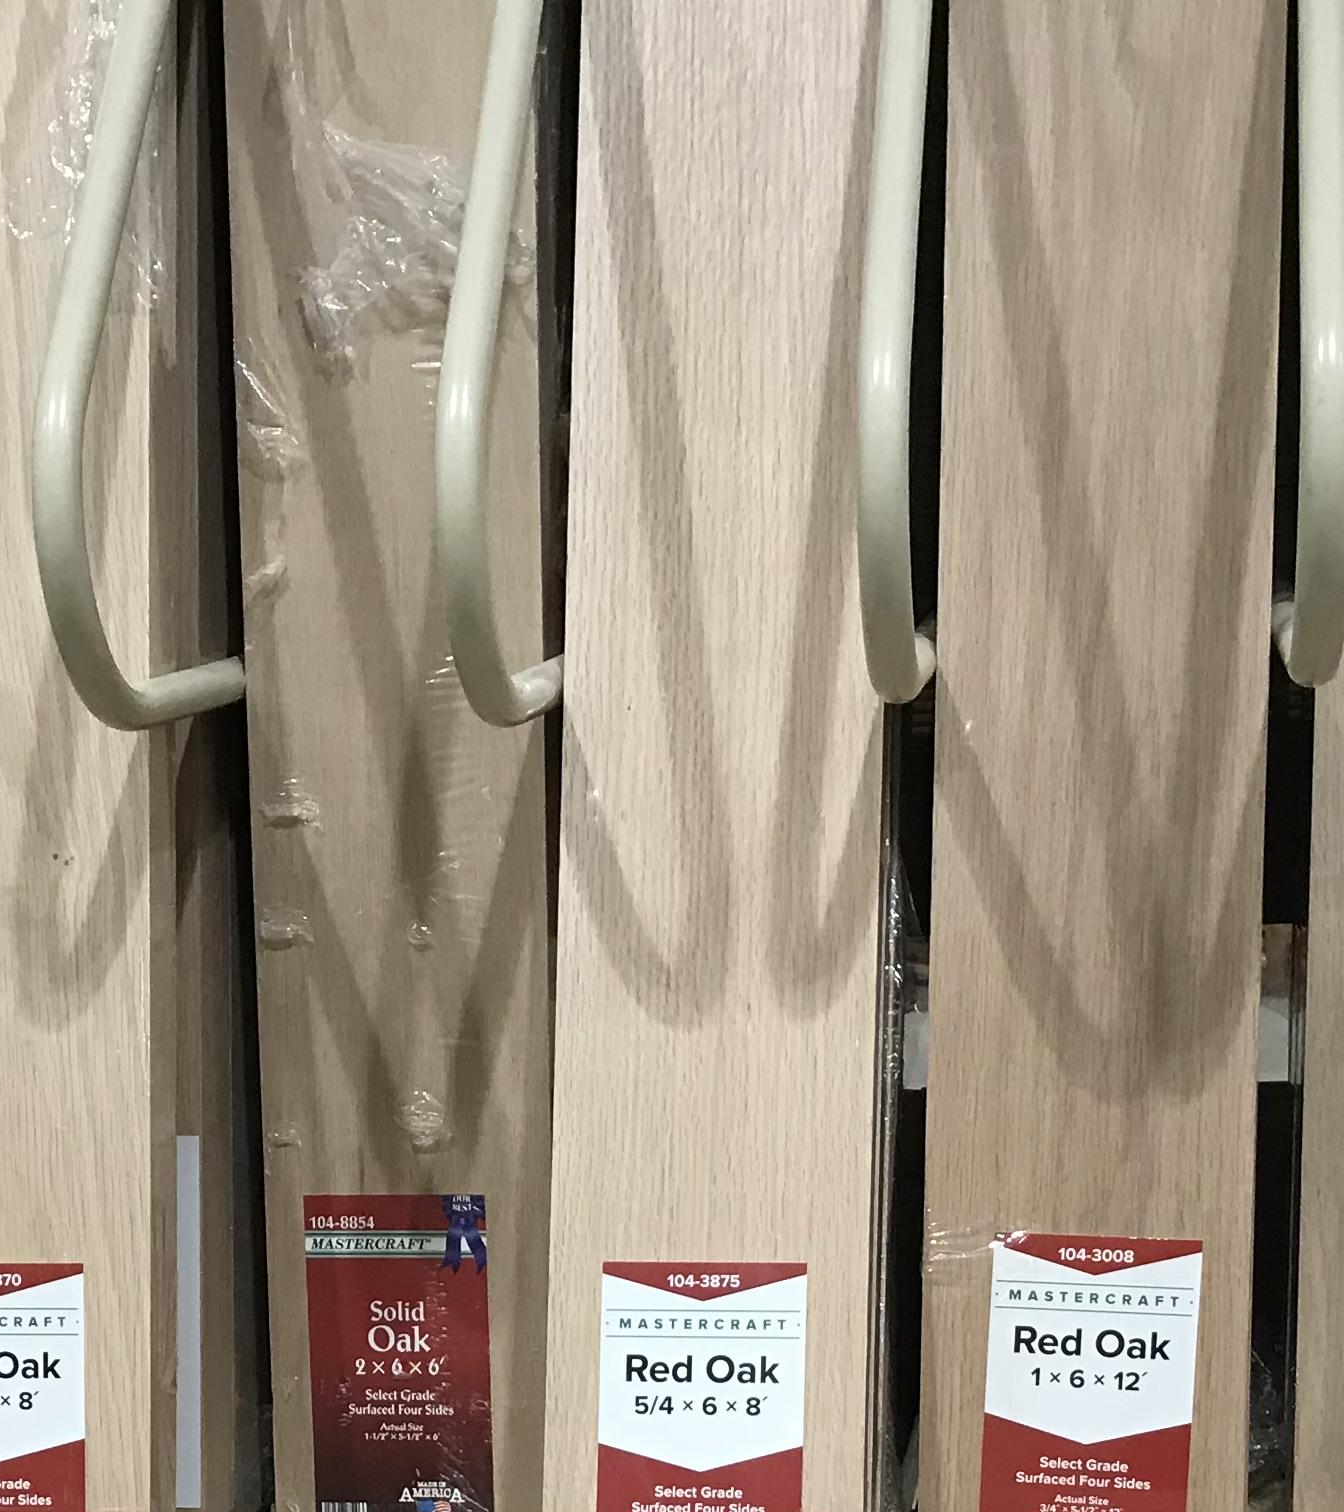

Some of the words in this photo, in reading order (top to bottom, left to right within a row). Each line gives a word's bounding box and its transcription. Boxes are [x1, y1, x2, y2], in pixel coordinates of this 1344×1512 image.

[309, 1216, 374, 1230] 104-8854
[311, 1239, 427, 1250] MASTERCRAFT
[1058, 1248, 1134, 1263] 104-3008
[667, 1274, 740, 1287] 104-3875
[1009, 1289, 1179, 1307] MASTERCRAFT
[370, 1300, 425, 1322] Solid
[620, 1318, 787, 1329] MASTERCRAFT
[368, 1325, 430, 1353] Oak
[1013, 1325, 1082, 1356] Red
[1095, 1329, 1171, 1360] Oak
[626, 1354, 692, 1383] Red
[706, 1355, 779, 1383] Oak
[365, 1389, 397, 1400] Select
[401, 1390, 435, 1401] Grade
[349, 1404, 396, 1416] Surfaced
[398, 1405, 422, 1416] Four
[425, 1405, 454, 1417] Sides
[1040, 1457, 1082, 1469] Select
[1086, 1459, 1128, 1472] Grade
[1016, 1472, 1075, 1485] Surfaced
[1079, 1475, 1111, 1487] Four
[1114, 1477, 1151, 1490] Sides
[655, 1486, 697, 1498] Select
[701, 1487, 743, 1499] Grade
[18, 1495, 52, 1506] Sides
[1055, 1494, 1086, 1505] Actual
[1089, 1496, 1108, 1506] Size
